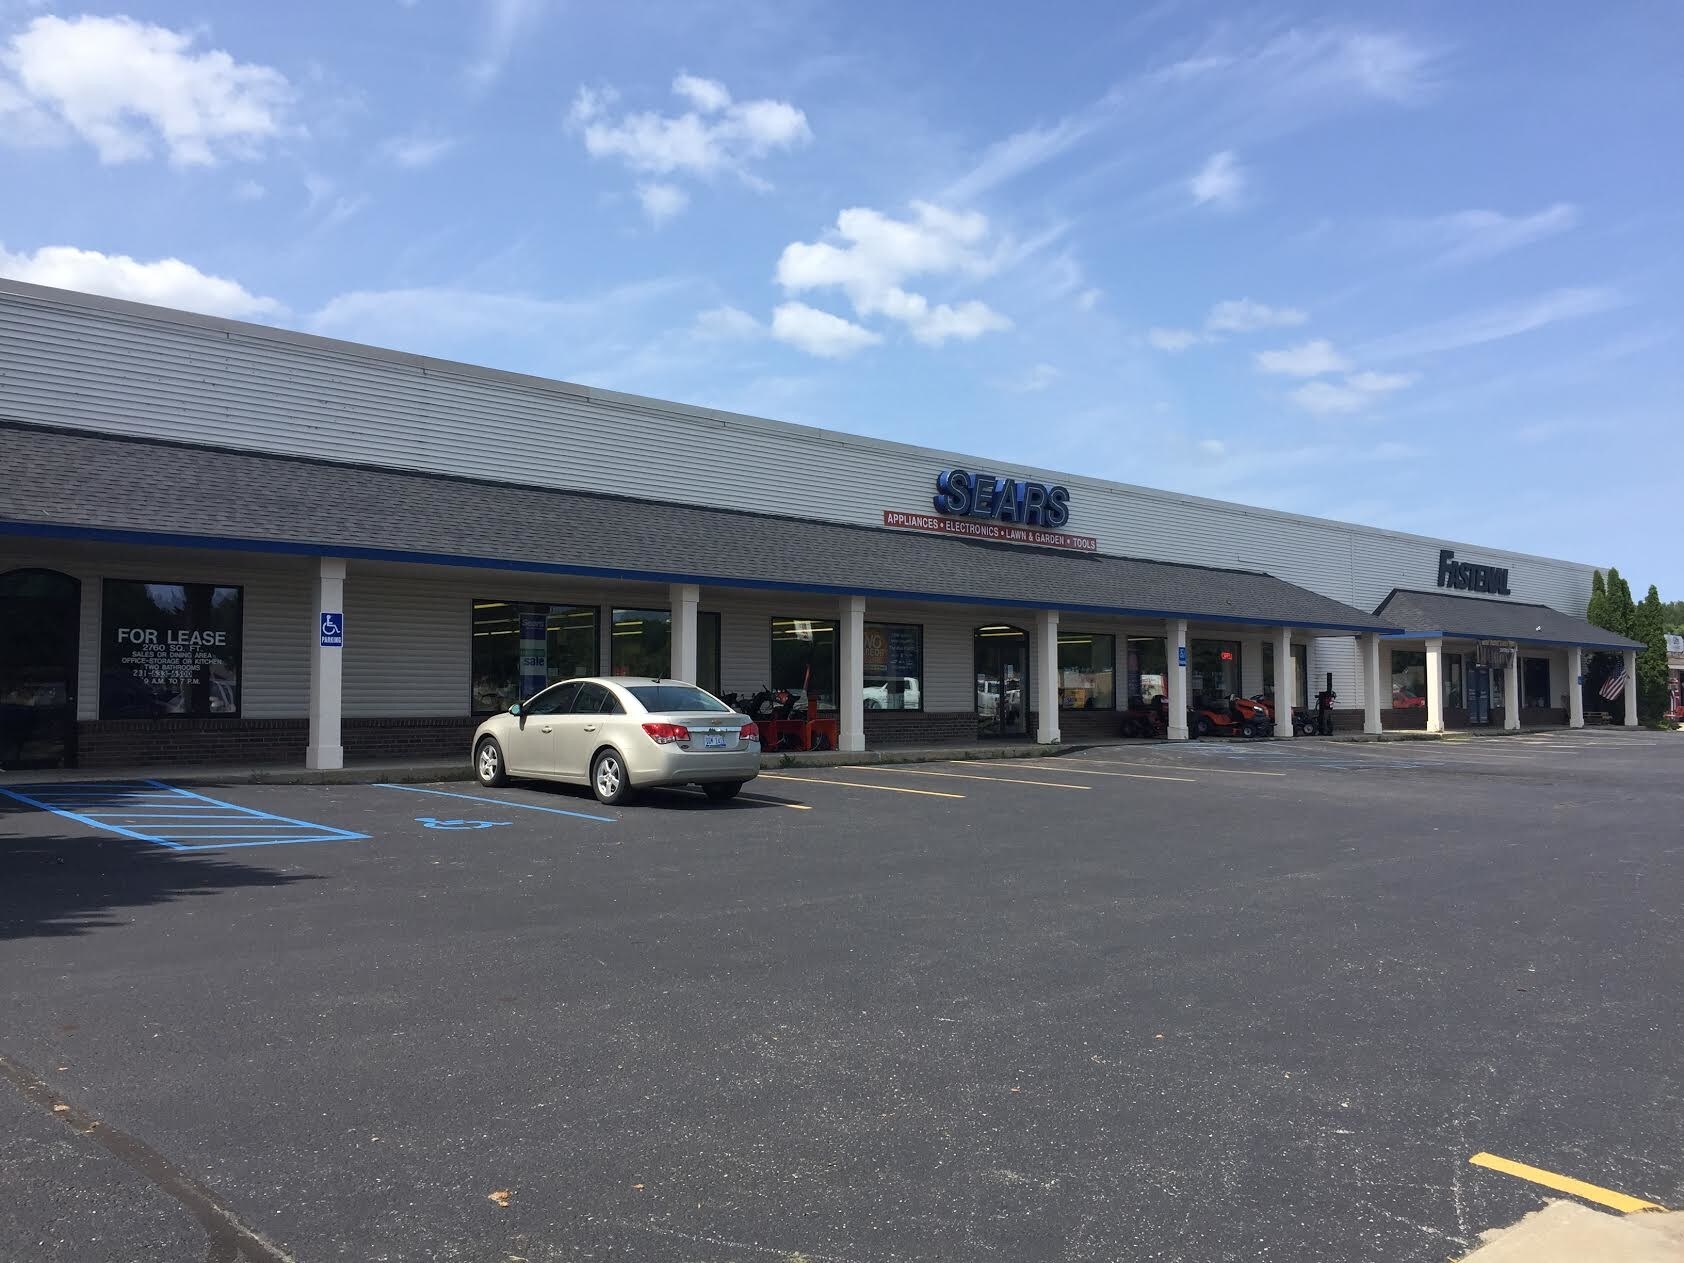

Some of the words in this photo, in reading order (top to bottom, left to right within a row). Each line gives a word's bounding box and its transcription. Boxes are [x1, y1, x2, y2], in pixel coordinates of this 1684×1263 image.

[933, 469, 1070, 528] SEARS
[887, 513, 939, 529] APPLIANCES
[946, 522, 999, 537] ELECTRONICS
[1005, 529, 1027, 540] LAWN
[1028, 532, 1034, 540] &
[1035, 532, 1065, 545] GARDEN
[1072, 538, 1096, 550] TOOLS
[118, 628, 158, 644] FOR
[167, 630, 226, 646] LEASE
[524, 657, 544, 666] sale
